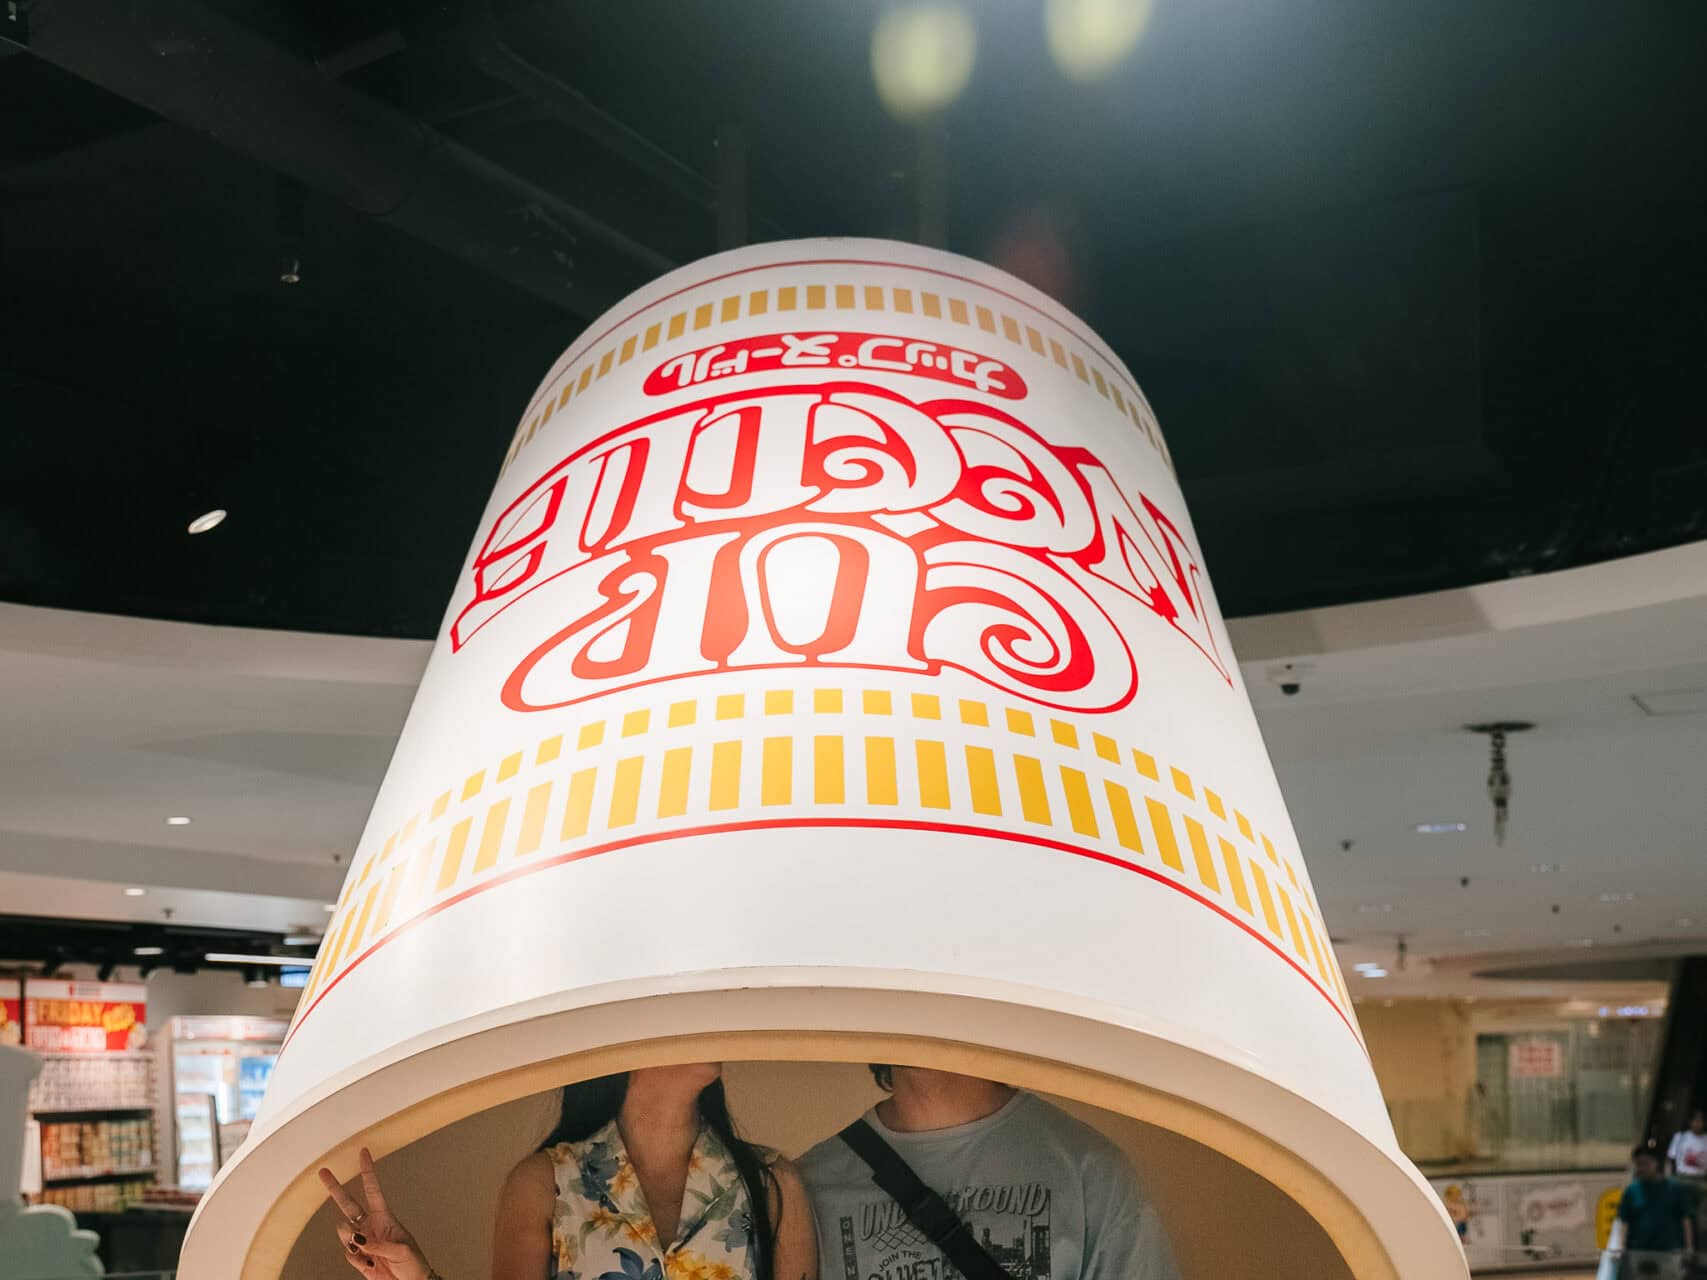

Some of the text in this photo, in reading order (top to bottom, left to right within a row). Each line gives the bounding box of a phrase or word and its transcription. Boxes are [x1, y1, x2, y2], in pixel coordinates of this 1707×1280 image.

[661, 334, 1006, 390] カップヌードル
[452, 383, 1232, 687] NOODLE
[501, 524, 1138, 713] CUP
[860, 1183, 1050, 1241] UNDROUND
[879, 1250, 921, 1271] JOIN THE
